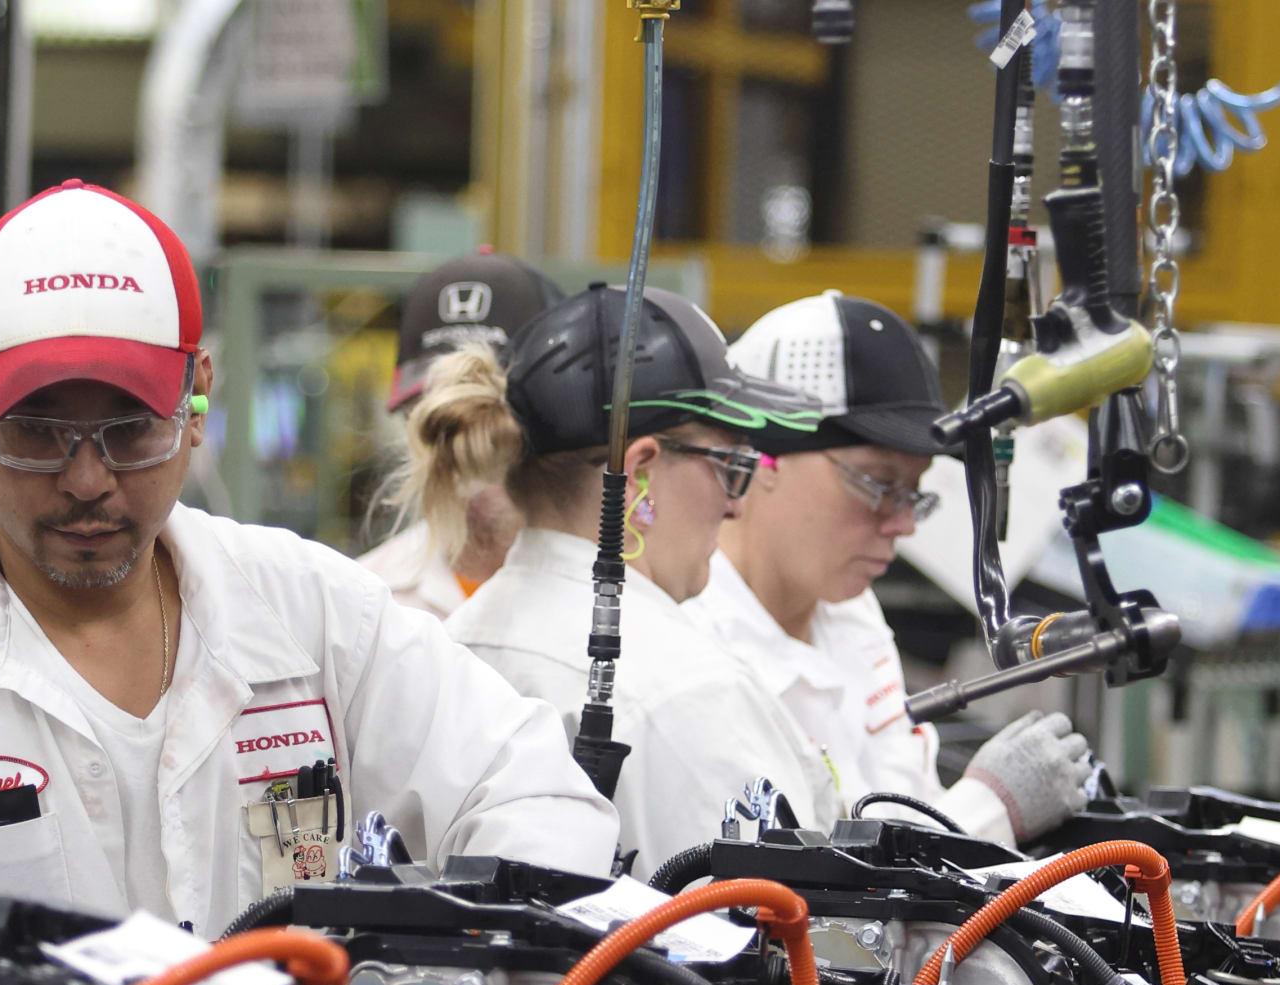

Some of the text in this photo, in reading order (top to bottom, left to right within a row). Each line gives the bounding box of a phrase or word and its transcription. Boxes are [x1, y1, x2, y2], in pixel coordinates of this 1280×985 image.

[23, 273, 144, 295] HONDA
[236, 729, 325, 754] HONDA
[282, 832, 331, 849] WE CARE
